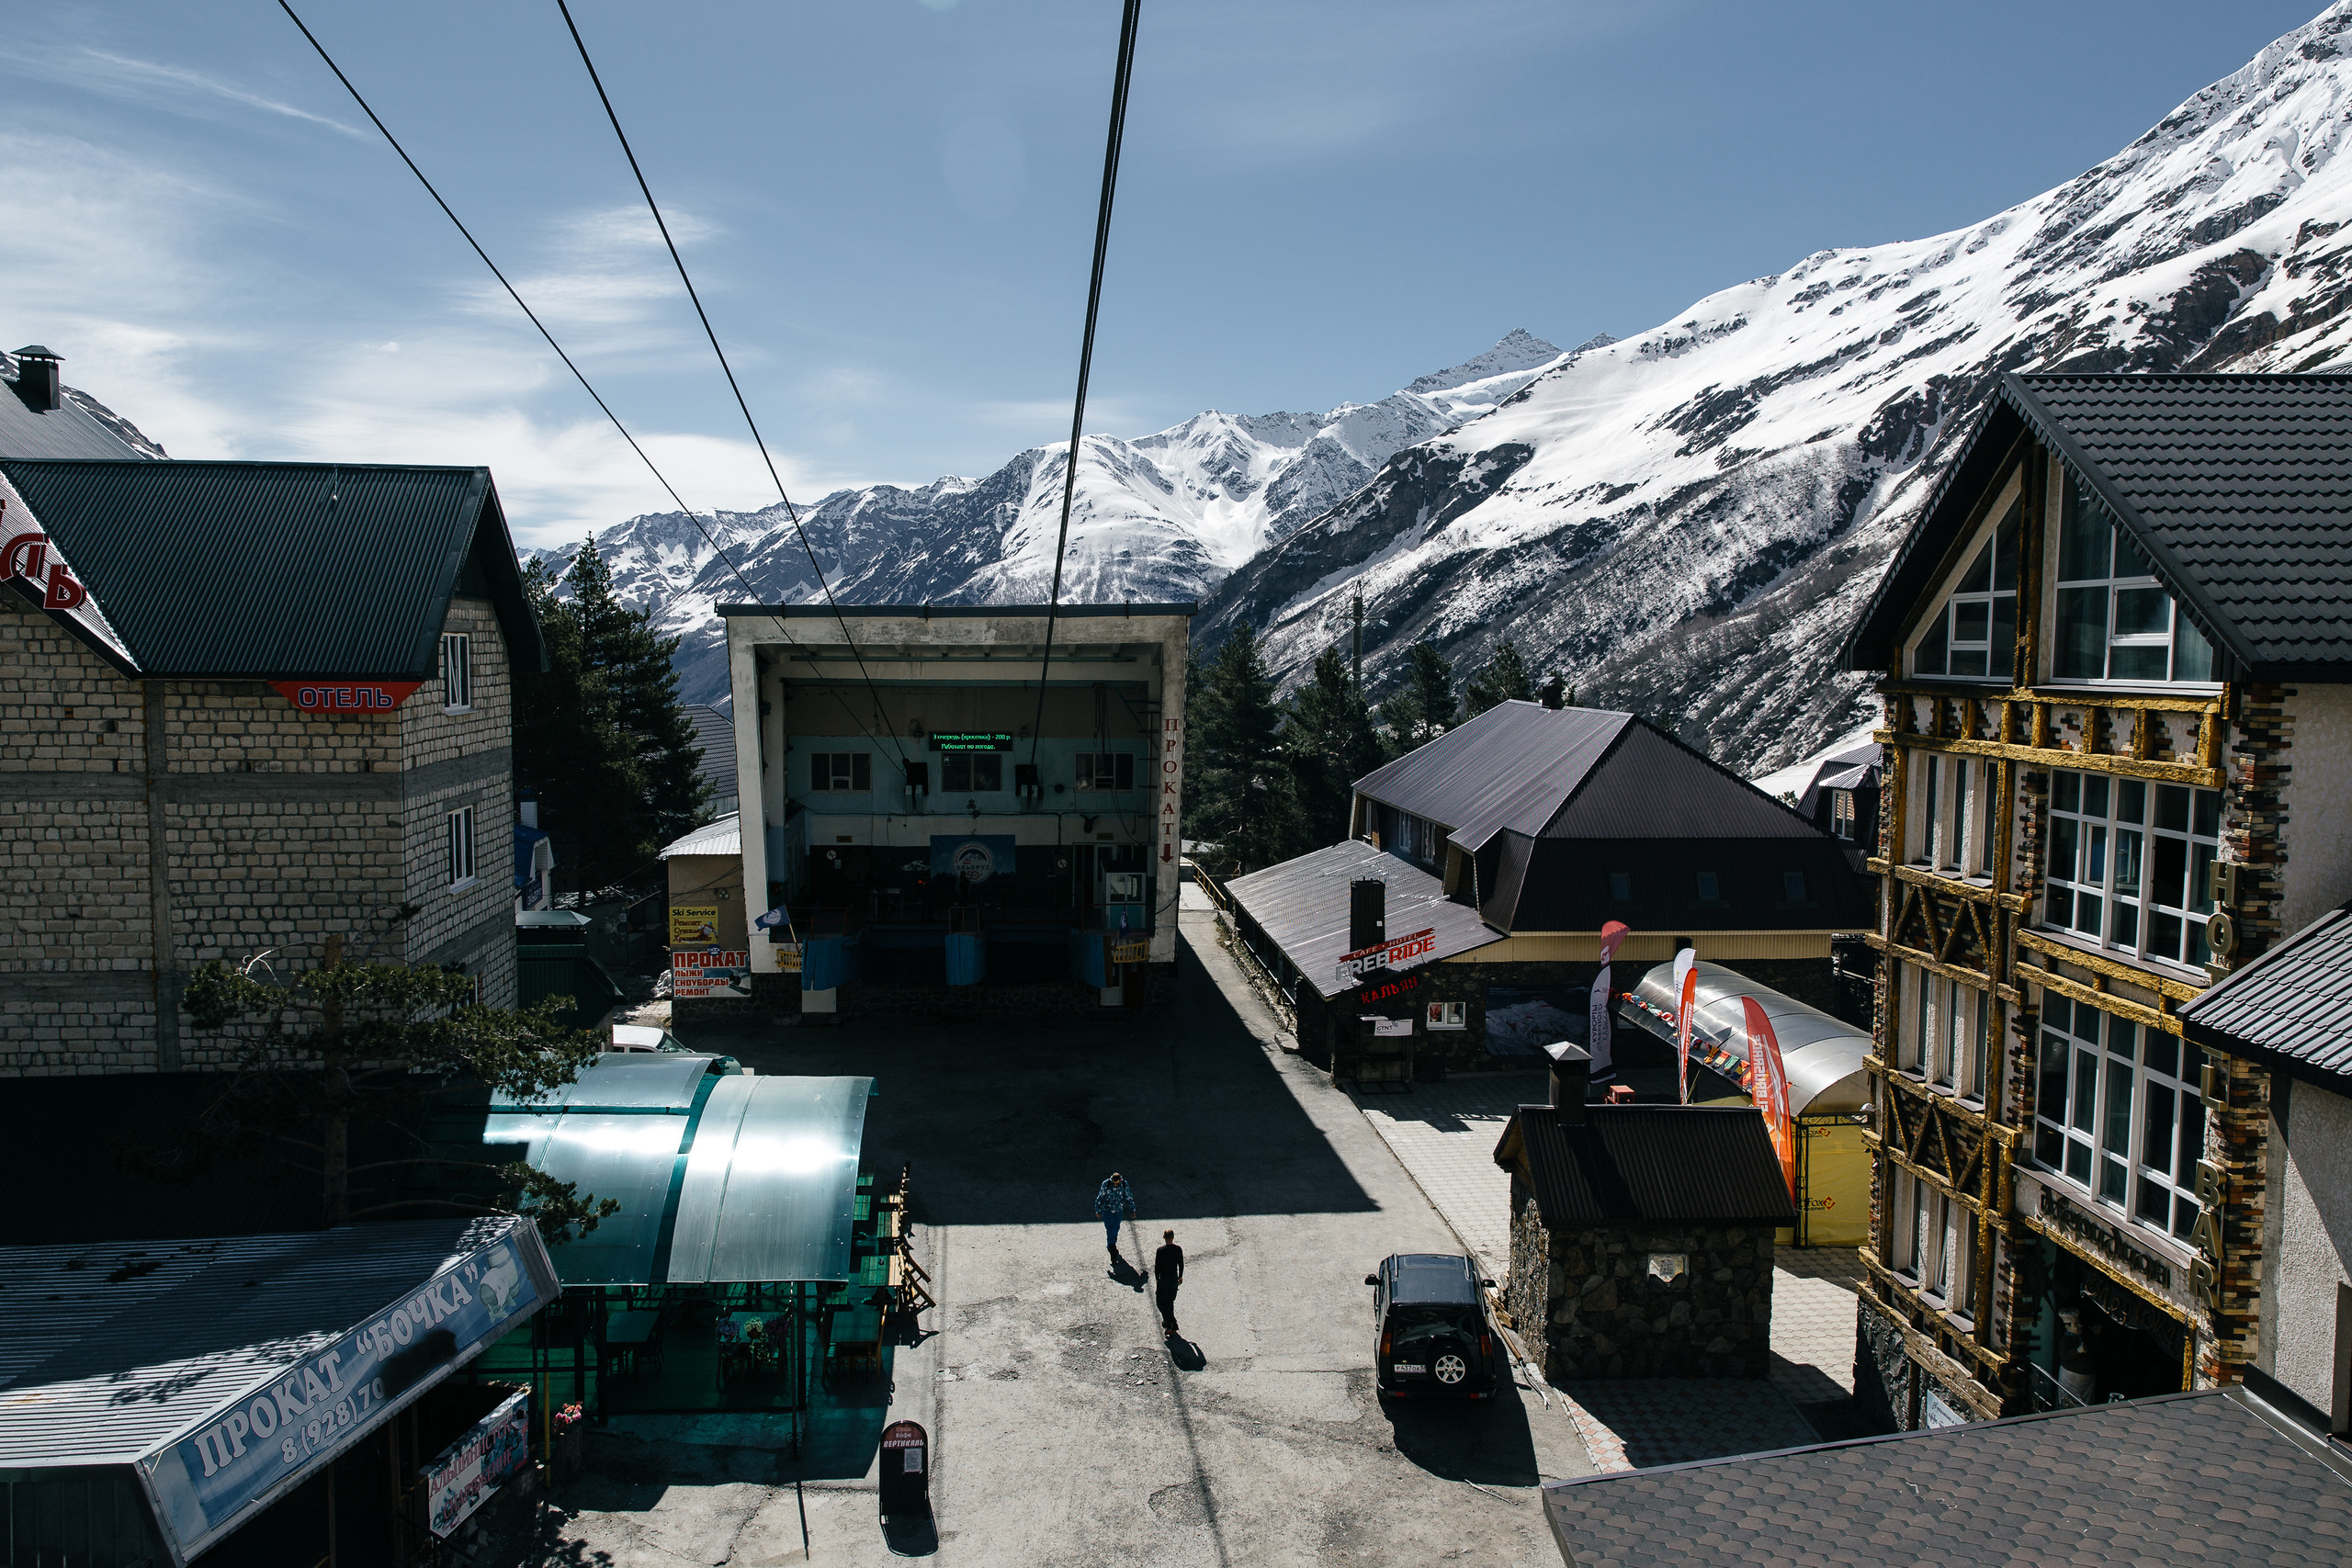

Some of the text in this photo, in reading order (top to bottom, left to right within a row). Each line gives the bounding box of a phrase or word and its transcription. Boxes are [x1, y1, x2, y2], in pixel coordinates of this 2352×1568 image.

[0, 497, 87, 610] ЛЬ
[298, 687, 393, 708] ОТЕЛЬ
[1161, 718, 1179, 835] ПРОКАТ
[672, 908, 717, 917] Ski Service
[673, 919, 702, 927] Ремонт
[1388, 933, 1419, 947] HOTEL
[673, 950, 748, 968] ПРОКАТ
[673, 969, 704, 977] ЛЫЖИ
[673, 977, 729, 987] СНОУБОРДЫ
[674, 987, 710, 997] РЕМОНТ
[1361, 976, 1419, 1005] КАЛЬЯН
[2188, 859, 2242, 1310] HOTL BAR
[193, 1348, 342, 1479] ПРОКАТ
[883, 1439, 924, 1448] ВЕРТИКАЛЬ
[443, 1446, 514, 1520] СНАРЯЖЕНИЕ
